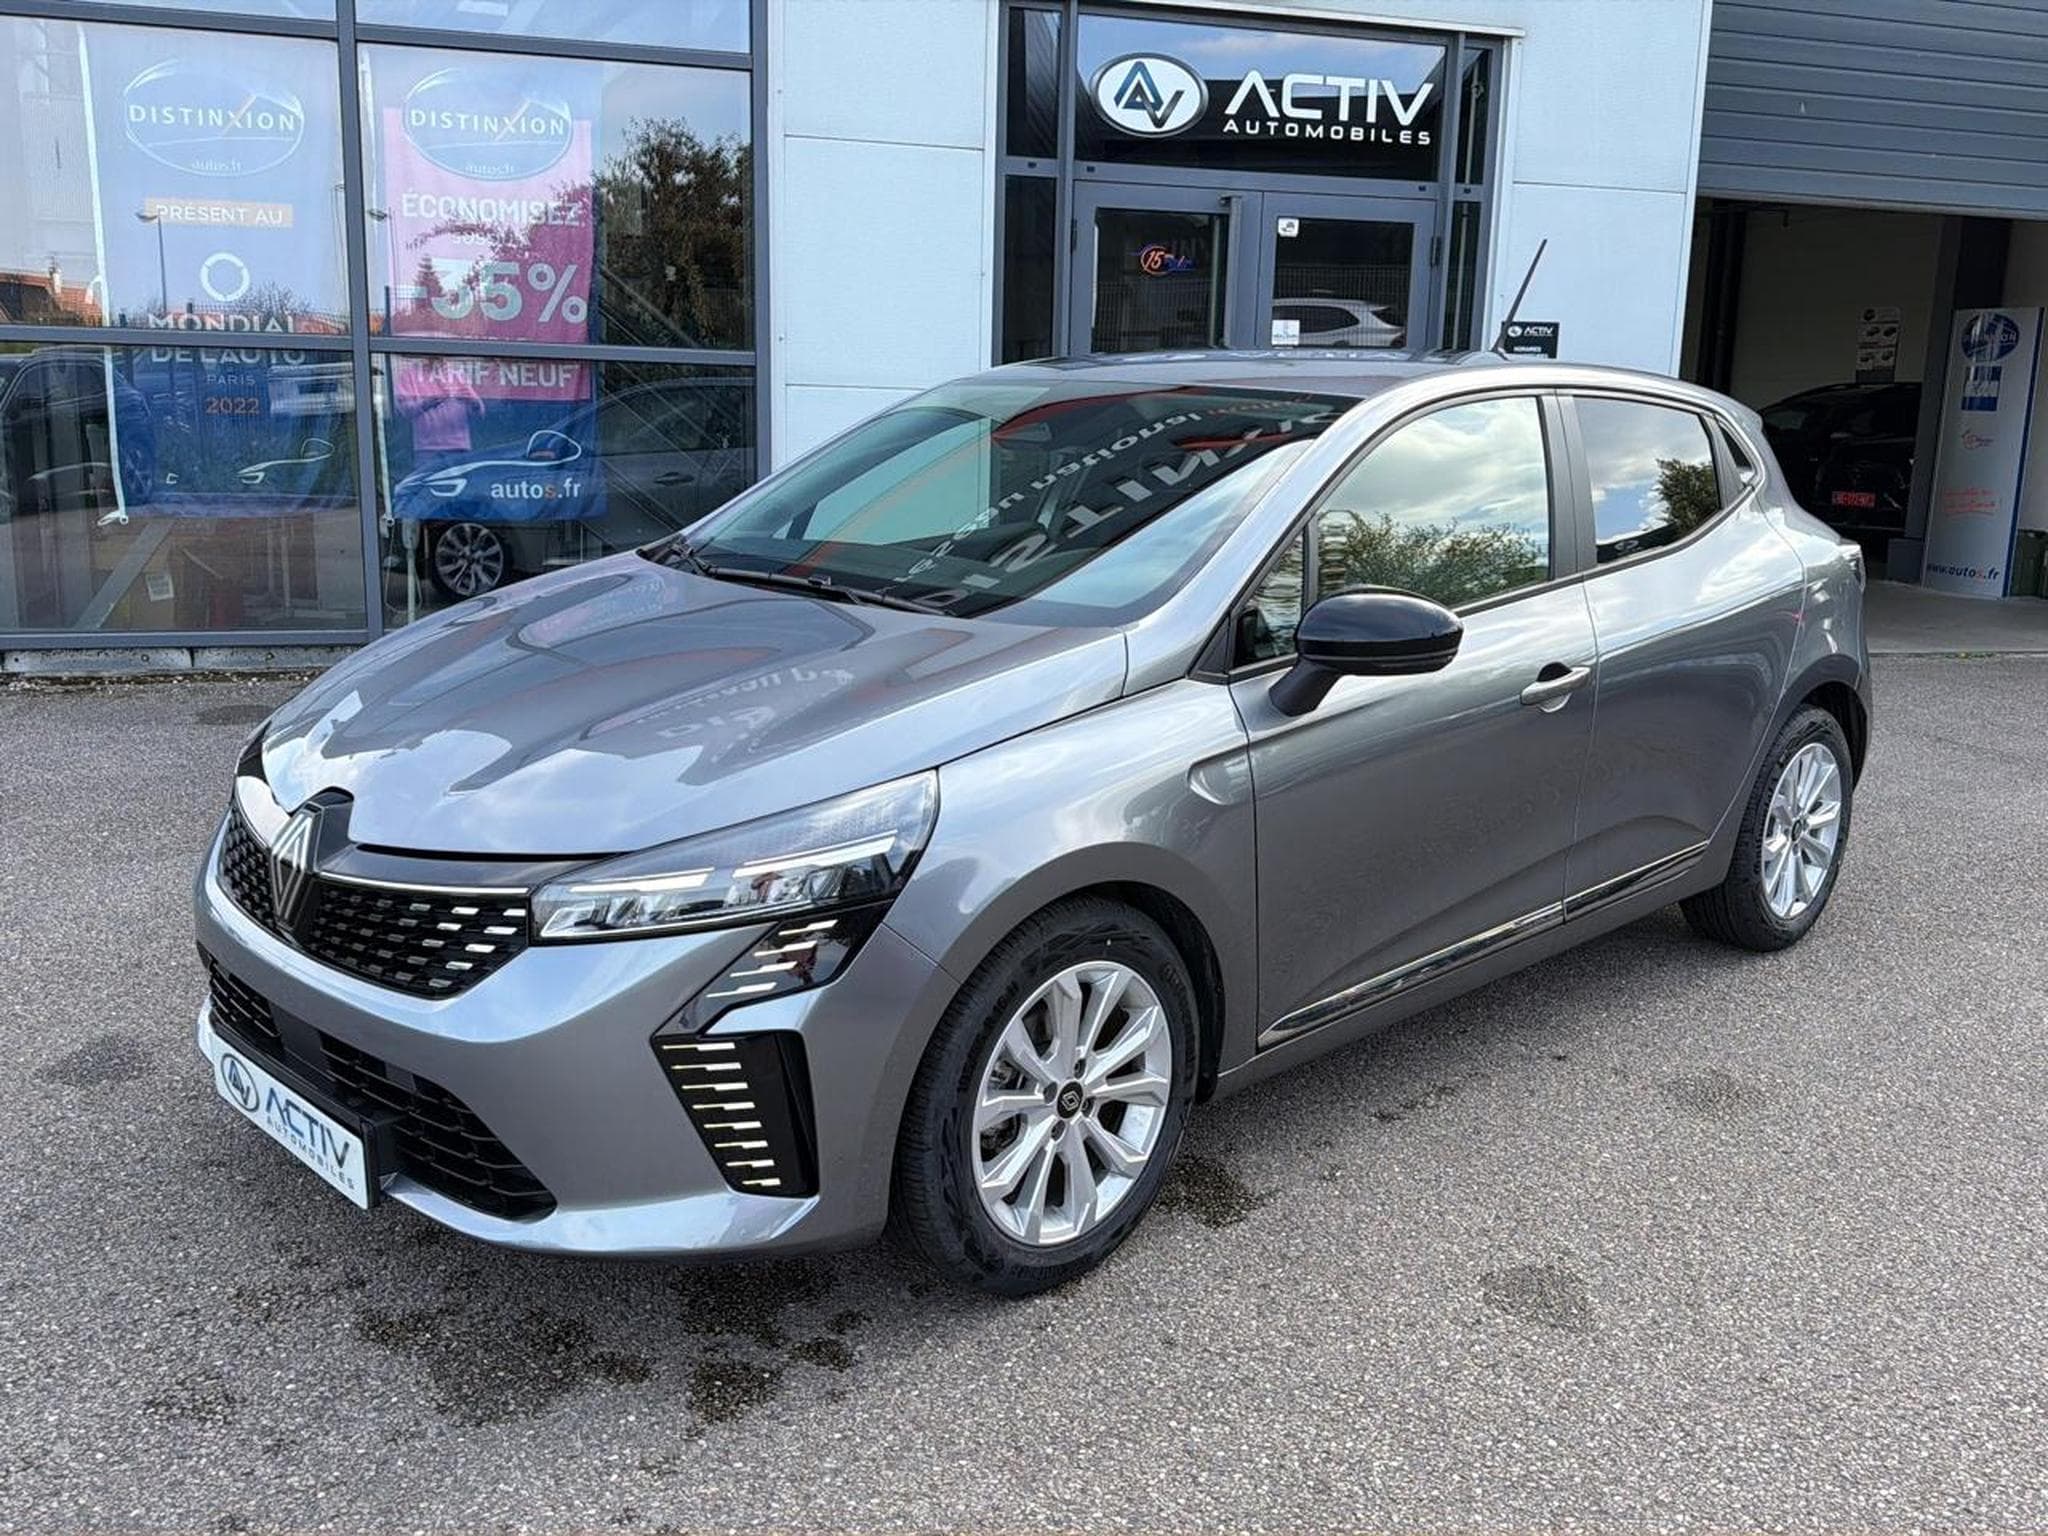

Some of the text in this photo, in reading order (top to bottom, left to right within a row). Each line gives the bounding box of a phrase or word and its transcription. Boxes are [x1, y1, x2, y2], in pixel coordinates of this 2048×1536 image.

[1224, 69, 1434, 127] ACTIV
[129, 104, 295, 132] DISTINXION
[410, 108, 565, 135] DISTINXION
[1223, 119, 1431, 145] AUTOMOBILES
[155, 202, 283, 224] PRÉSENT AU
[402, 187, 582, 226] ÉCONOMISEZ
[206, 374, 256, 386] PARIS
[417, 361, 580, 388] TARIF NEUF
[206, 396, 260, 415] 2022
[490, 478, 582, 500] autos.fr
[265, 1087, 350, 1169] ACTIV
[266, 1115, 356, 1191] AUTOMOBILES
